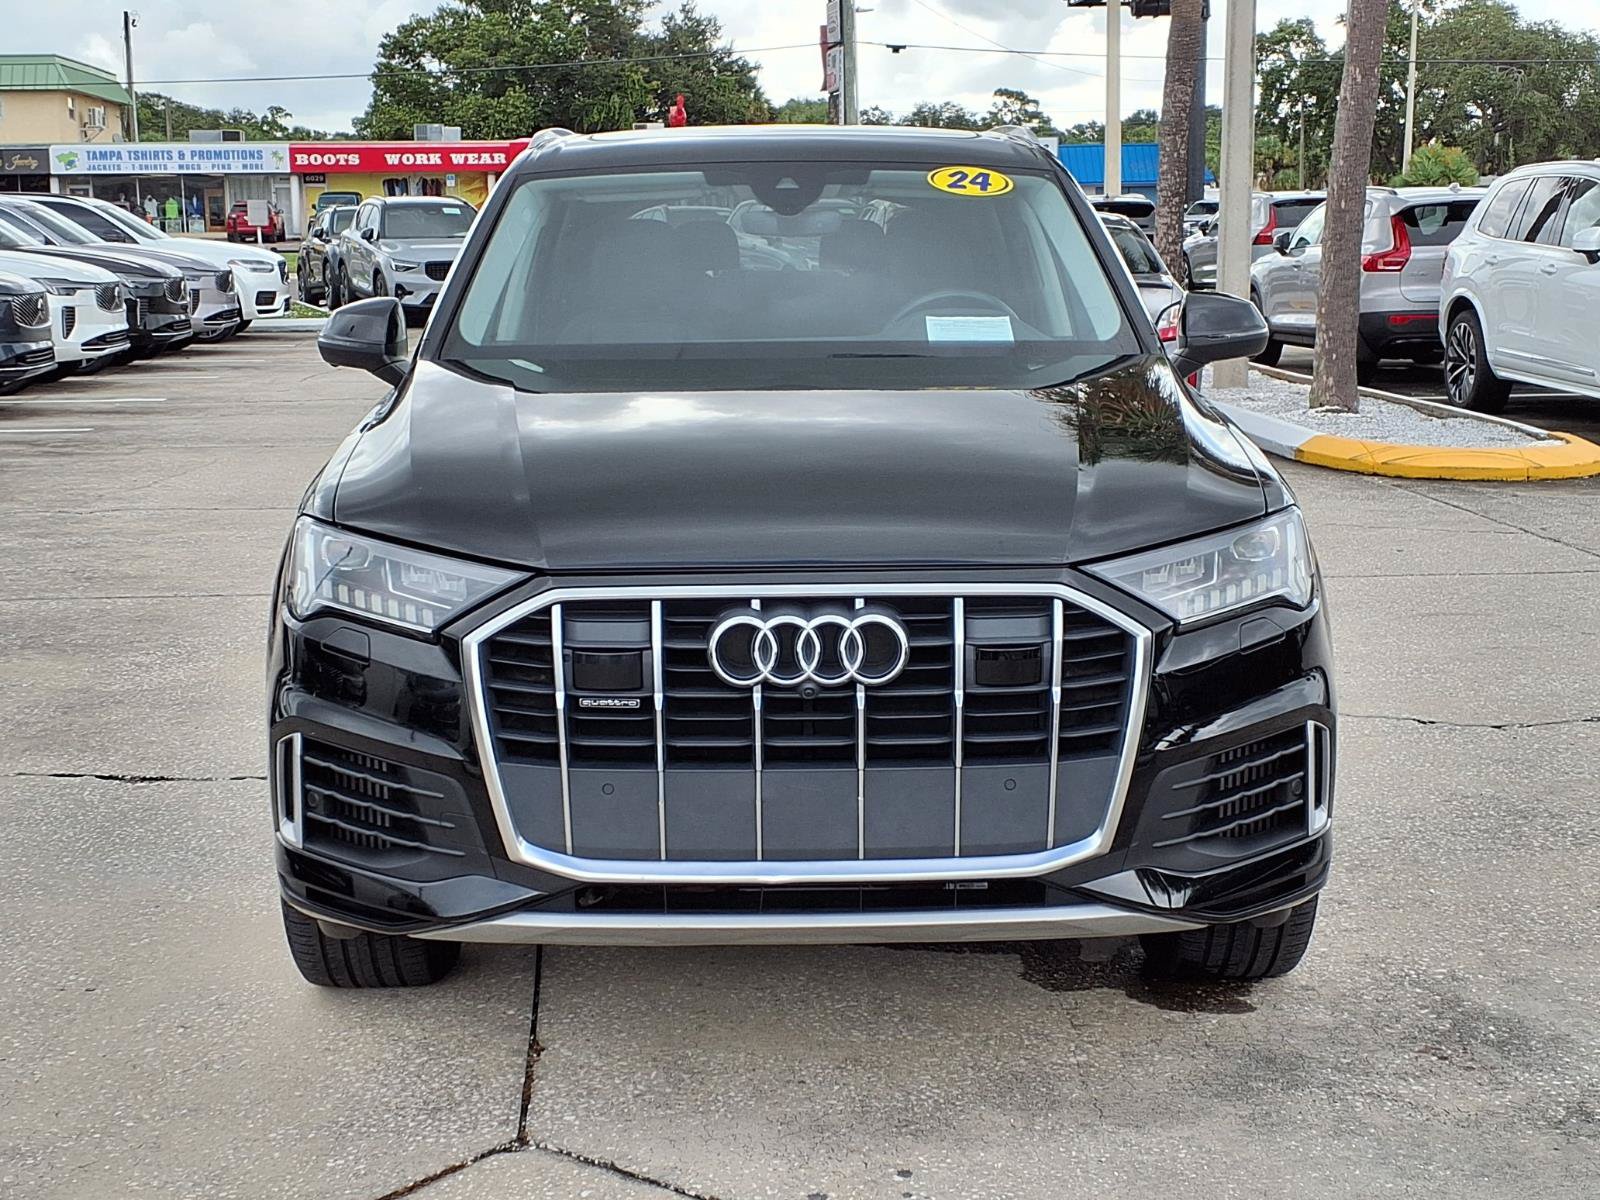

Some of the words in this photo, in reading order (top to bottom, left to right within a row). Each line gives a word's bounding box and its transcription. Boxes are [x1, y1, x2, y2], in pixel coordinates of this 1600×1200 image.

[86, 150, 123, 161] TAMPA
[127, 150, 173, 161] TSHIRTS
[178, 150, 186, 161] &
[191, 150, 264, 161] PROMOTIONS
[295, 153, 360, 165] BOOTS
[385, 153, 443, 165] WORK
[450, 152, 507, 165] WEAR
[87, 163, 122, 171] JACKETS
[178, 163, 201, 171] MUGS
[211, 163, 232, 171] PENS
[241, 163, 264, 171] MORE
[946, 170, 992, 191] 24
[582, 699, 637, 707] quattro
